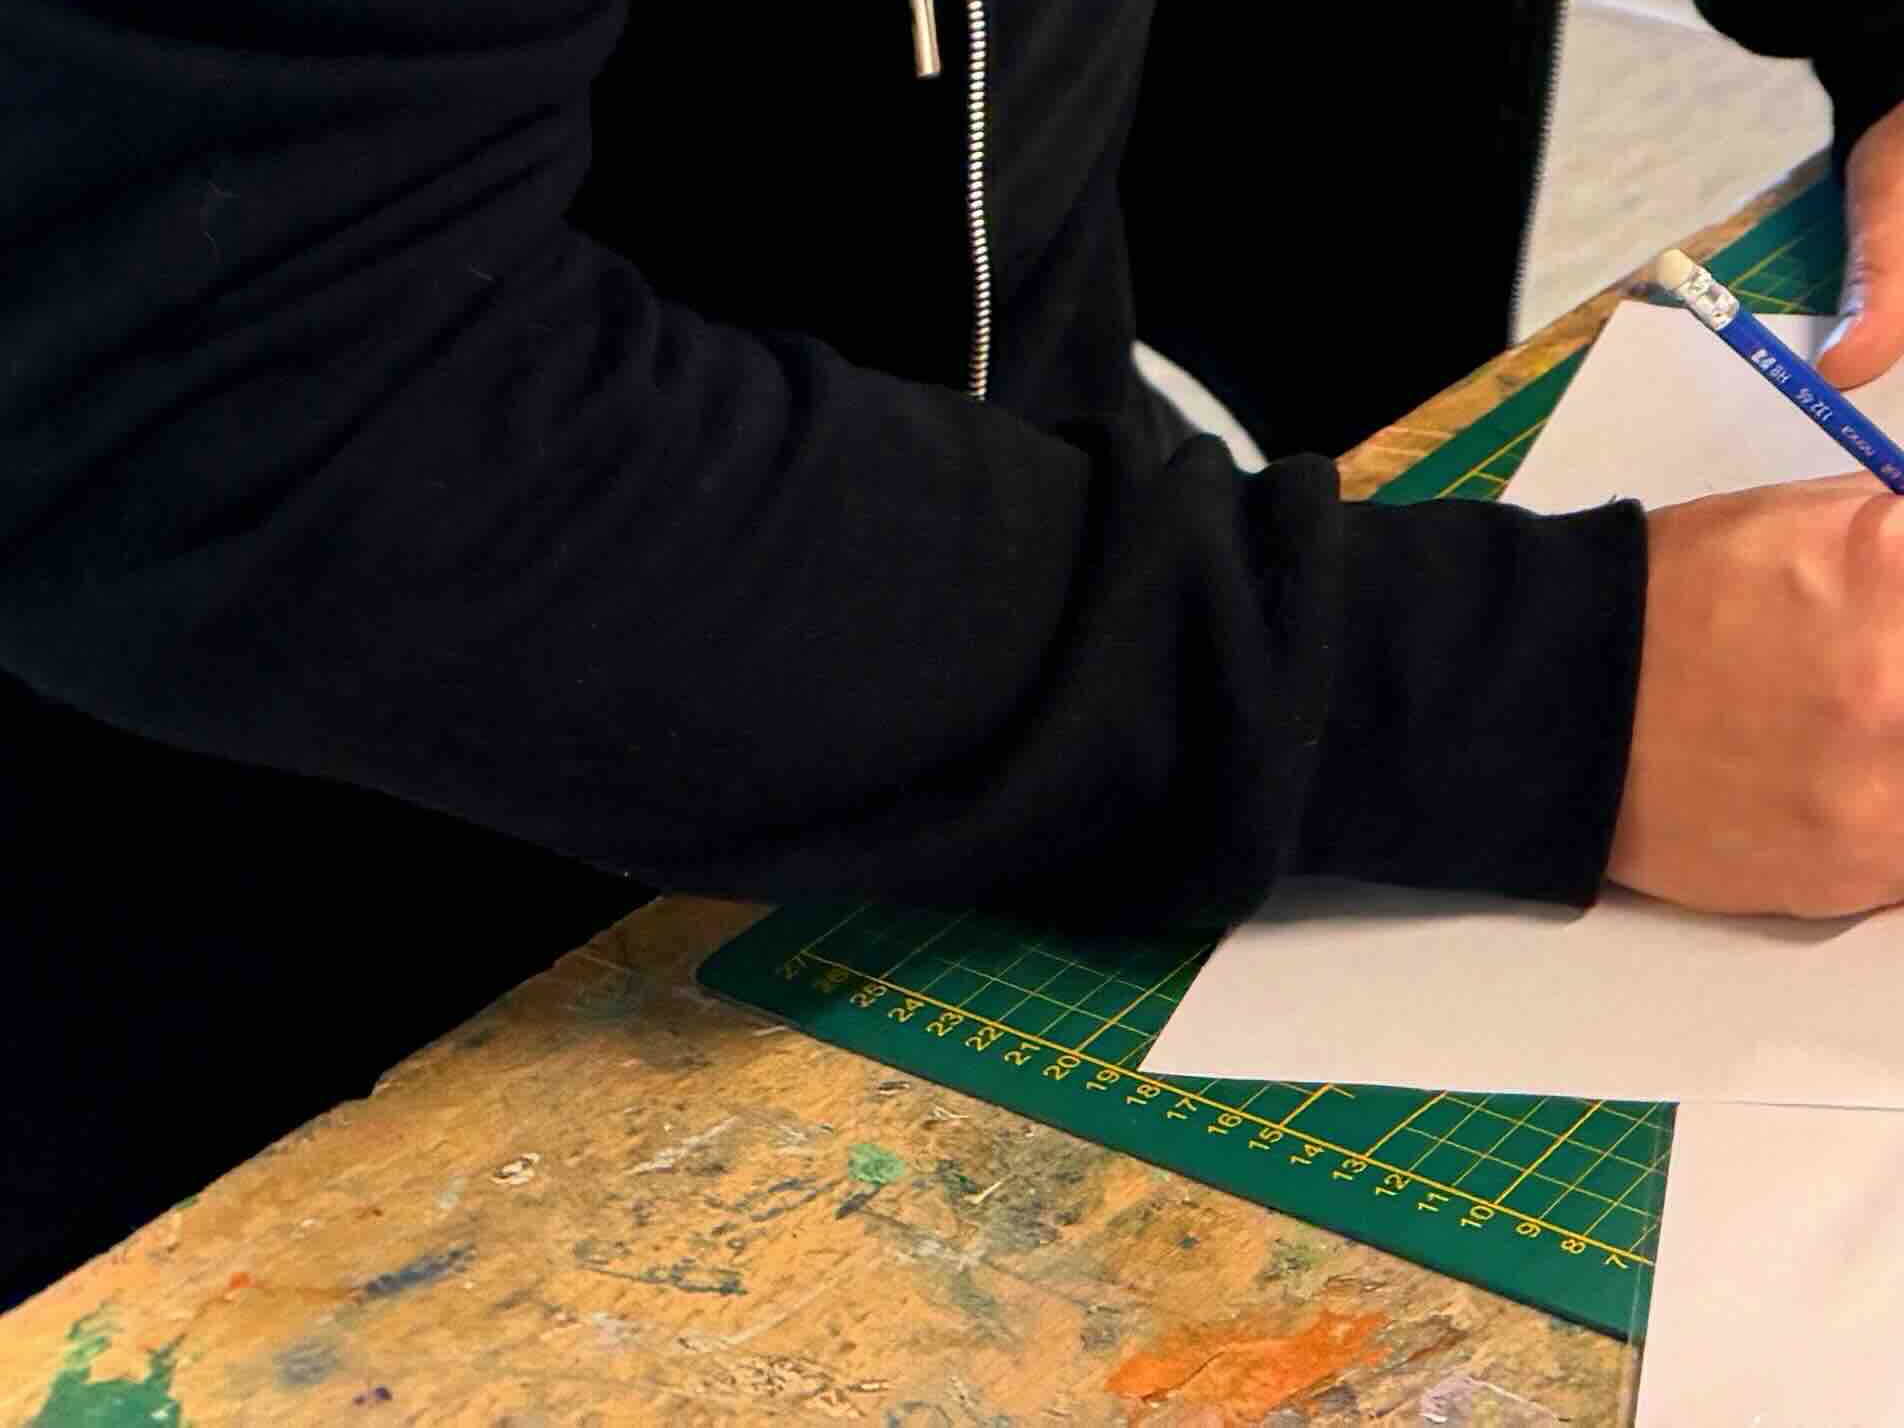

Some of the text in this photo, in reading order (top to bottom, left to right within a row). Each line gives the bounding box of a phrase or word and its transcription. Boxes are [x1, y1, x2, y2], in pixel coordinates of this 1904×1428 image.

[851, 980, 891, 1009] 25
[888, 998, 925, 1024] 24
[927, 1009, 965, 1038] 23
[966, 1023, 1007, 1052] 22
[1004, 1042, 1040, 1067] 21
[1043, 1053, 1083, 1082] 20
[1087, 1067, 1124, 1091] 19
[1126, 1082, 1165, 1106] 18
[1167, 1095, 1198, 1121] 17
[1207, 1112, 1245, 1135] 16
[1248, 1126, 1285, 1151] 15
[1289, 1142, 1324, 1166] 14
[1331, 1158, 1368, 1182] 13
[1376, 1173, 1412, 1197] 12
[1416, 1191, 1450, 1213] 11
[1460, 1202, 1496, 1228] 10
[1515, 1221, 1542, 1239] 9
[1561, 1236, 1587, 1255] 8
[1605, 1253, 1629, 1271] 7
